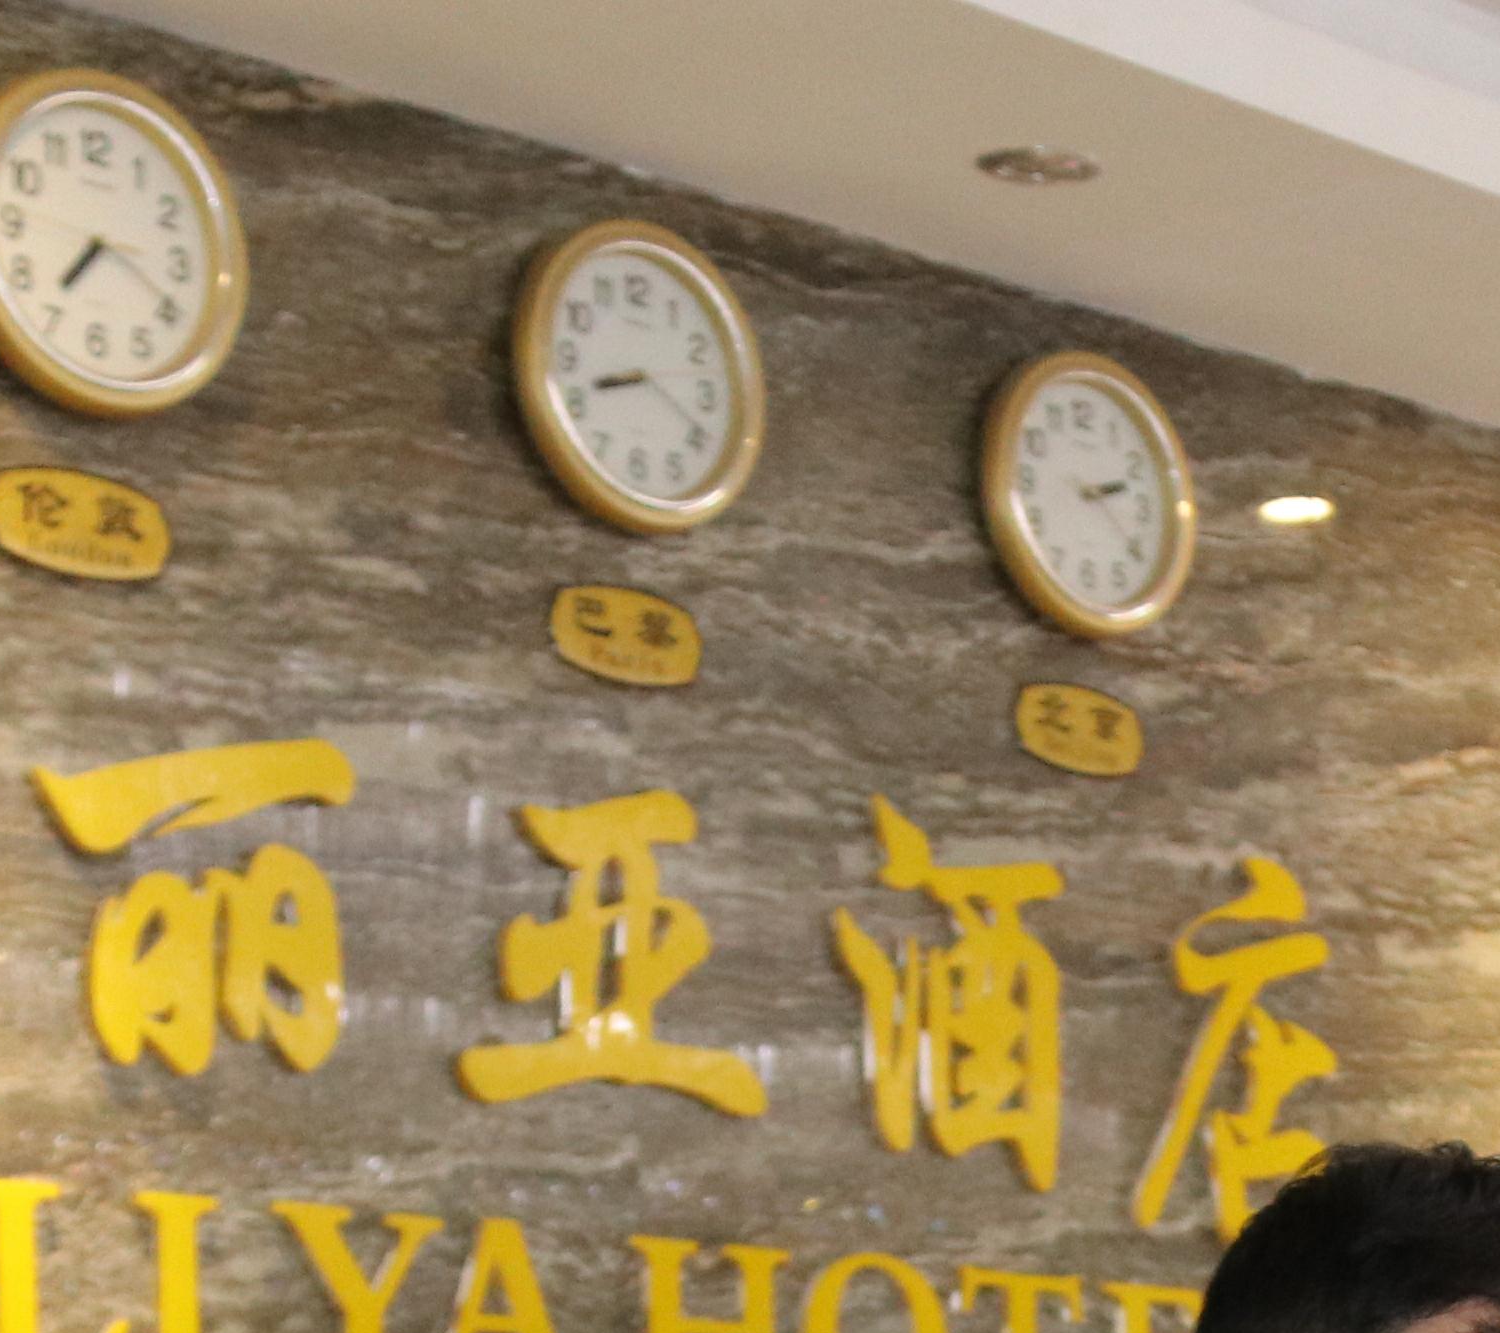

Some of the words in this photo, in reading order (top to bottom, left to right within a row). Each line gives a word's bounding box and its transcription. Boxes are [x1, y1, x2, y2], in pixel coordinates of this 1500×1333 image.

[80, 128, 113, 168] 12
[10, 157, 42, 195] 10
[131, 156, 147, 192] 1
[0, 203, 24, 239] 9
[158, 193, 179, 230] 2
[10, 254, 32, 291] 8
[167, 246, 190, 282] 3
[44, 304, 63, 334] 7
[86, 322, 110, 358] 6
[130, 326, 153, 358] 5
[18, 484, 142, 542] 伦敦
